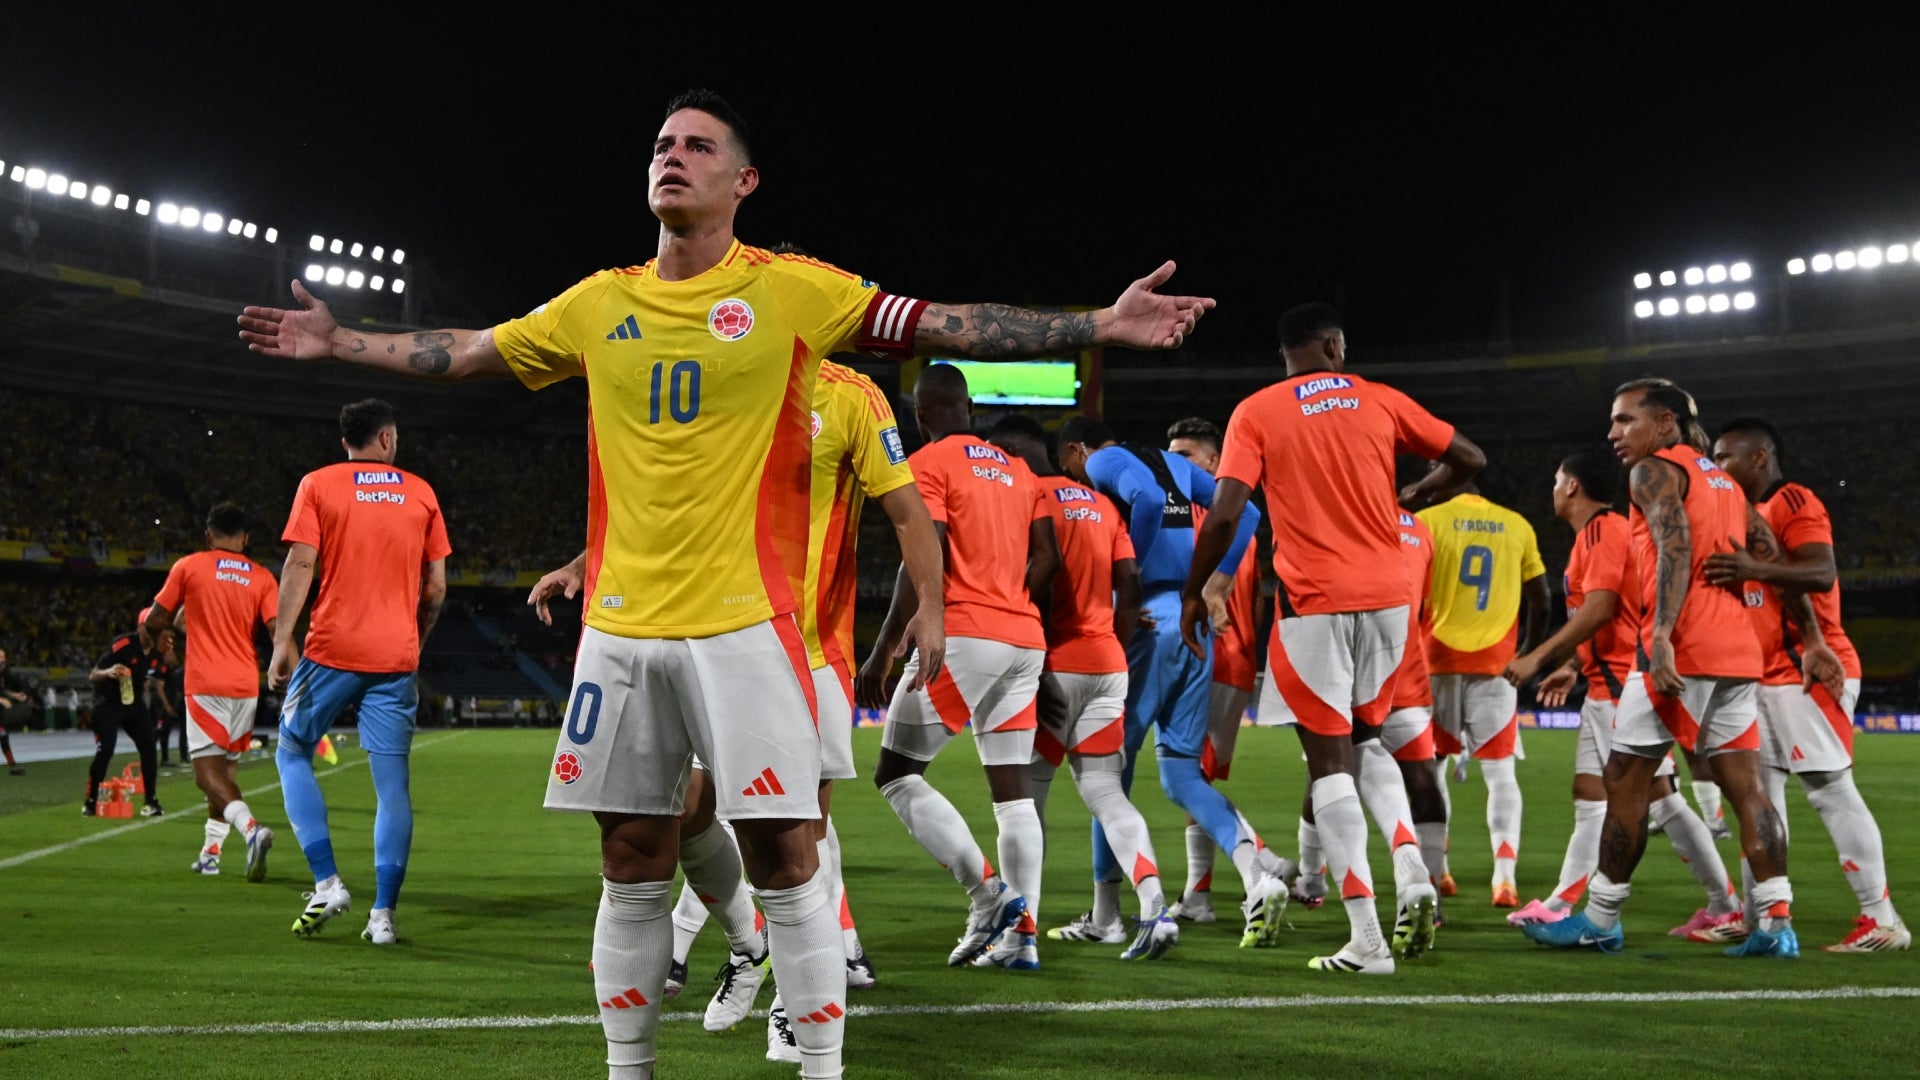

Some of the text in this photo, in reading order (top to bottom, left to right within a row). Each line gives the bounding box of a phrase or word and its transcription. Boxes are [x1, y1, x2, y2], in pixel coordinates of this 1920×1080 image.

[649, 360, 701, 424] 10
[1299, 378, 1351, 400] AGUILA
[1301, 397, 1359, 416] BetPlay
[968, 446, 1007, 465] AGUILA
[357, 472, 401, 485] AGUILA
[356, 490, 405, 505] BetPlay
[1059, 488, 1094, 503] AGUILA
[218, 559, 251, 573] AGUILA
[215, 571, 251, 587] BetPlay
[1459, 545, 1493, 612] 9
[567, 681, 603, 745] 0
